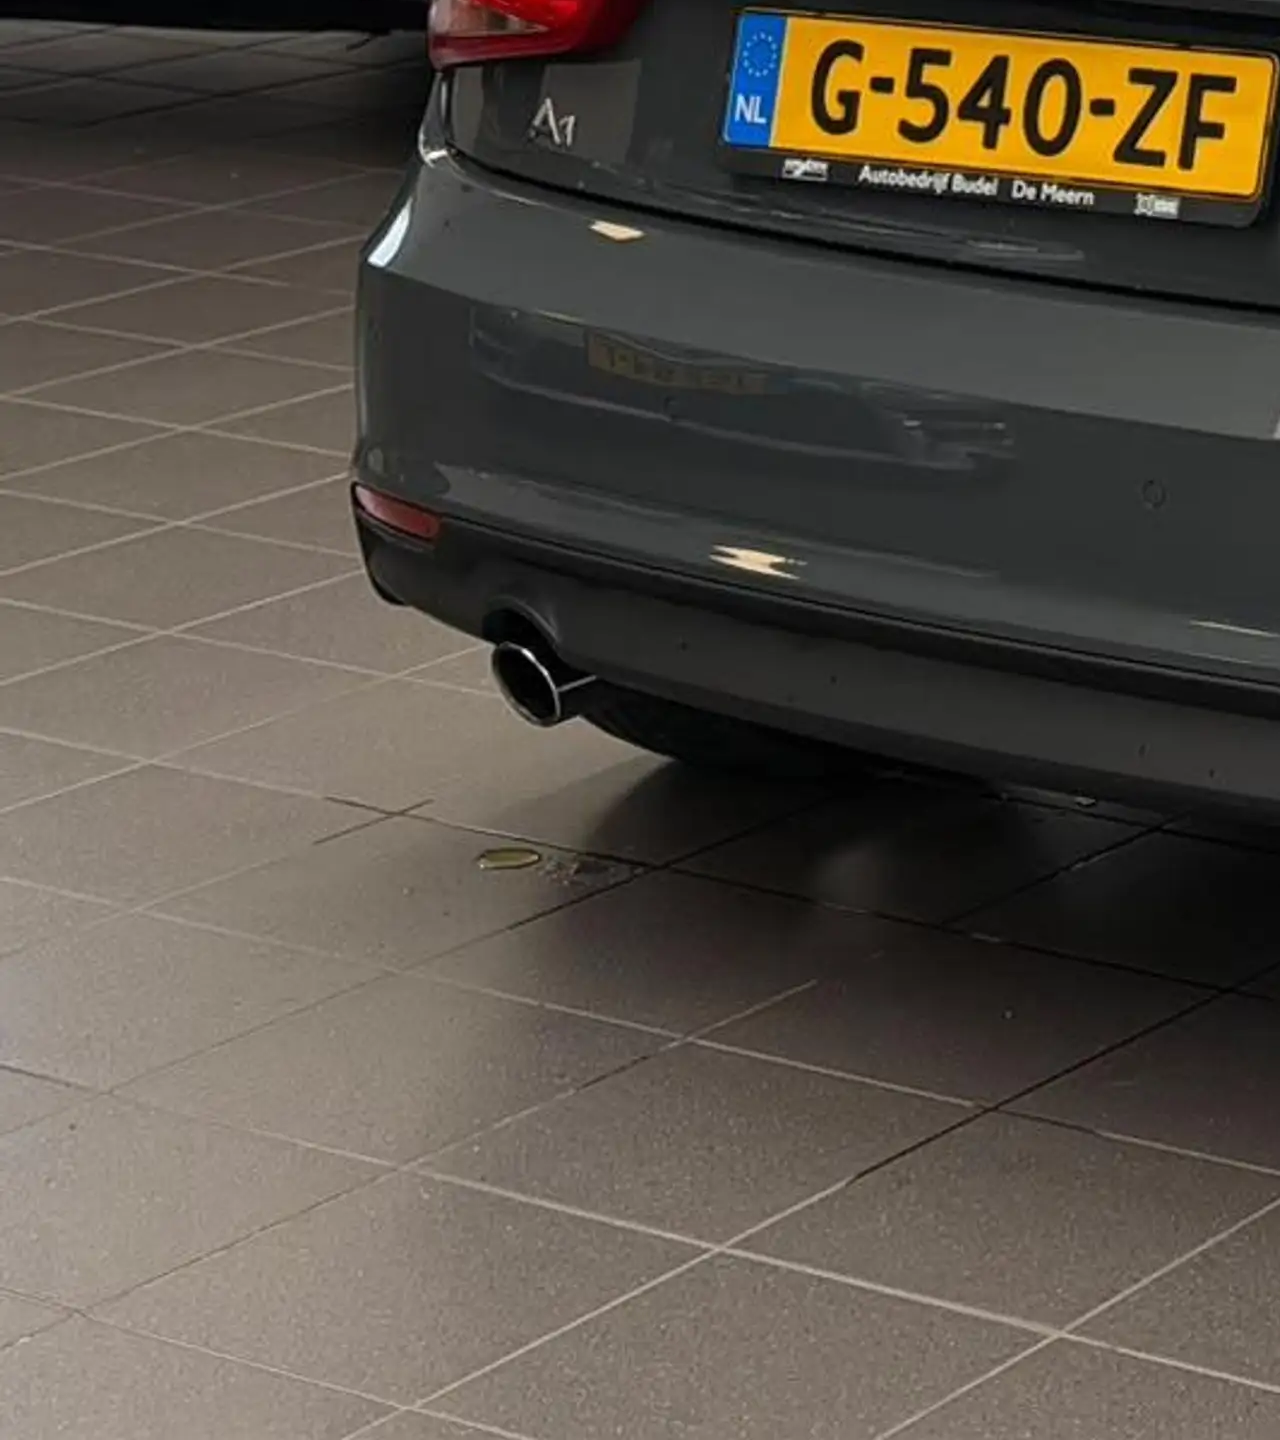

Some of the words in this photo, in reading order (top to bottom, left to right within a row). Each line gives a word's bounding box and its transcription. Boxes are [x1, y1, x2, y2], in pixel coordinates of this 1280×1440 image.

[526, 96, 577, 148] A1
[735, 94, 768, 126] NL
[810, 38, 1238, 173] G-540-ZF
[858, 164, 950, 196] Autobedrijf
[951, 168, 999, 197] Budel
[1011, 179, 1037, 201] De
[1040, 183, 1096, 207] Meern
